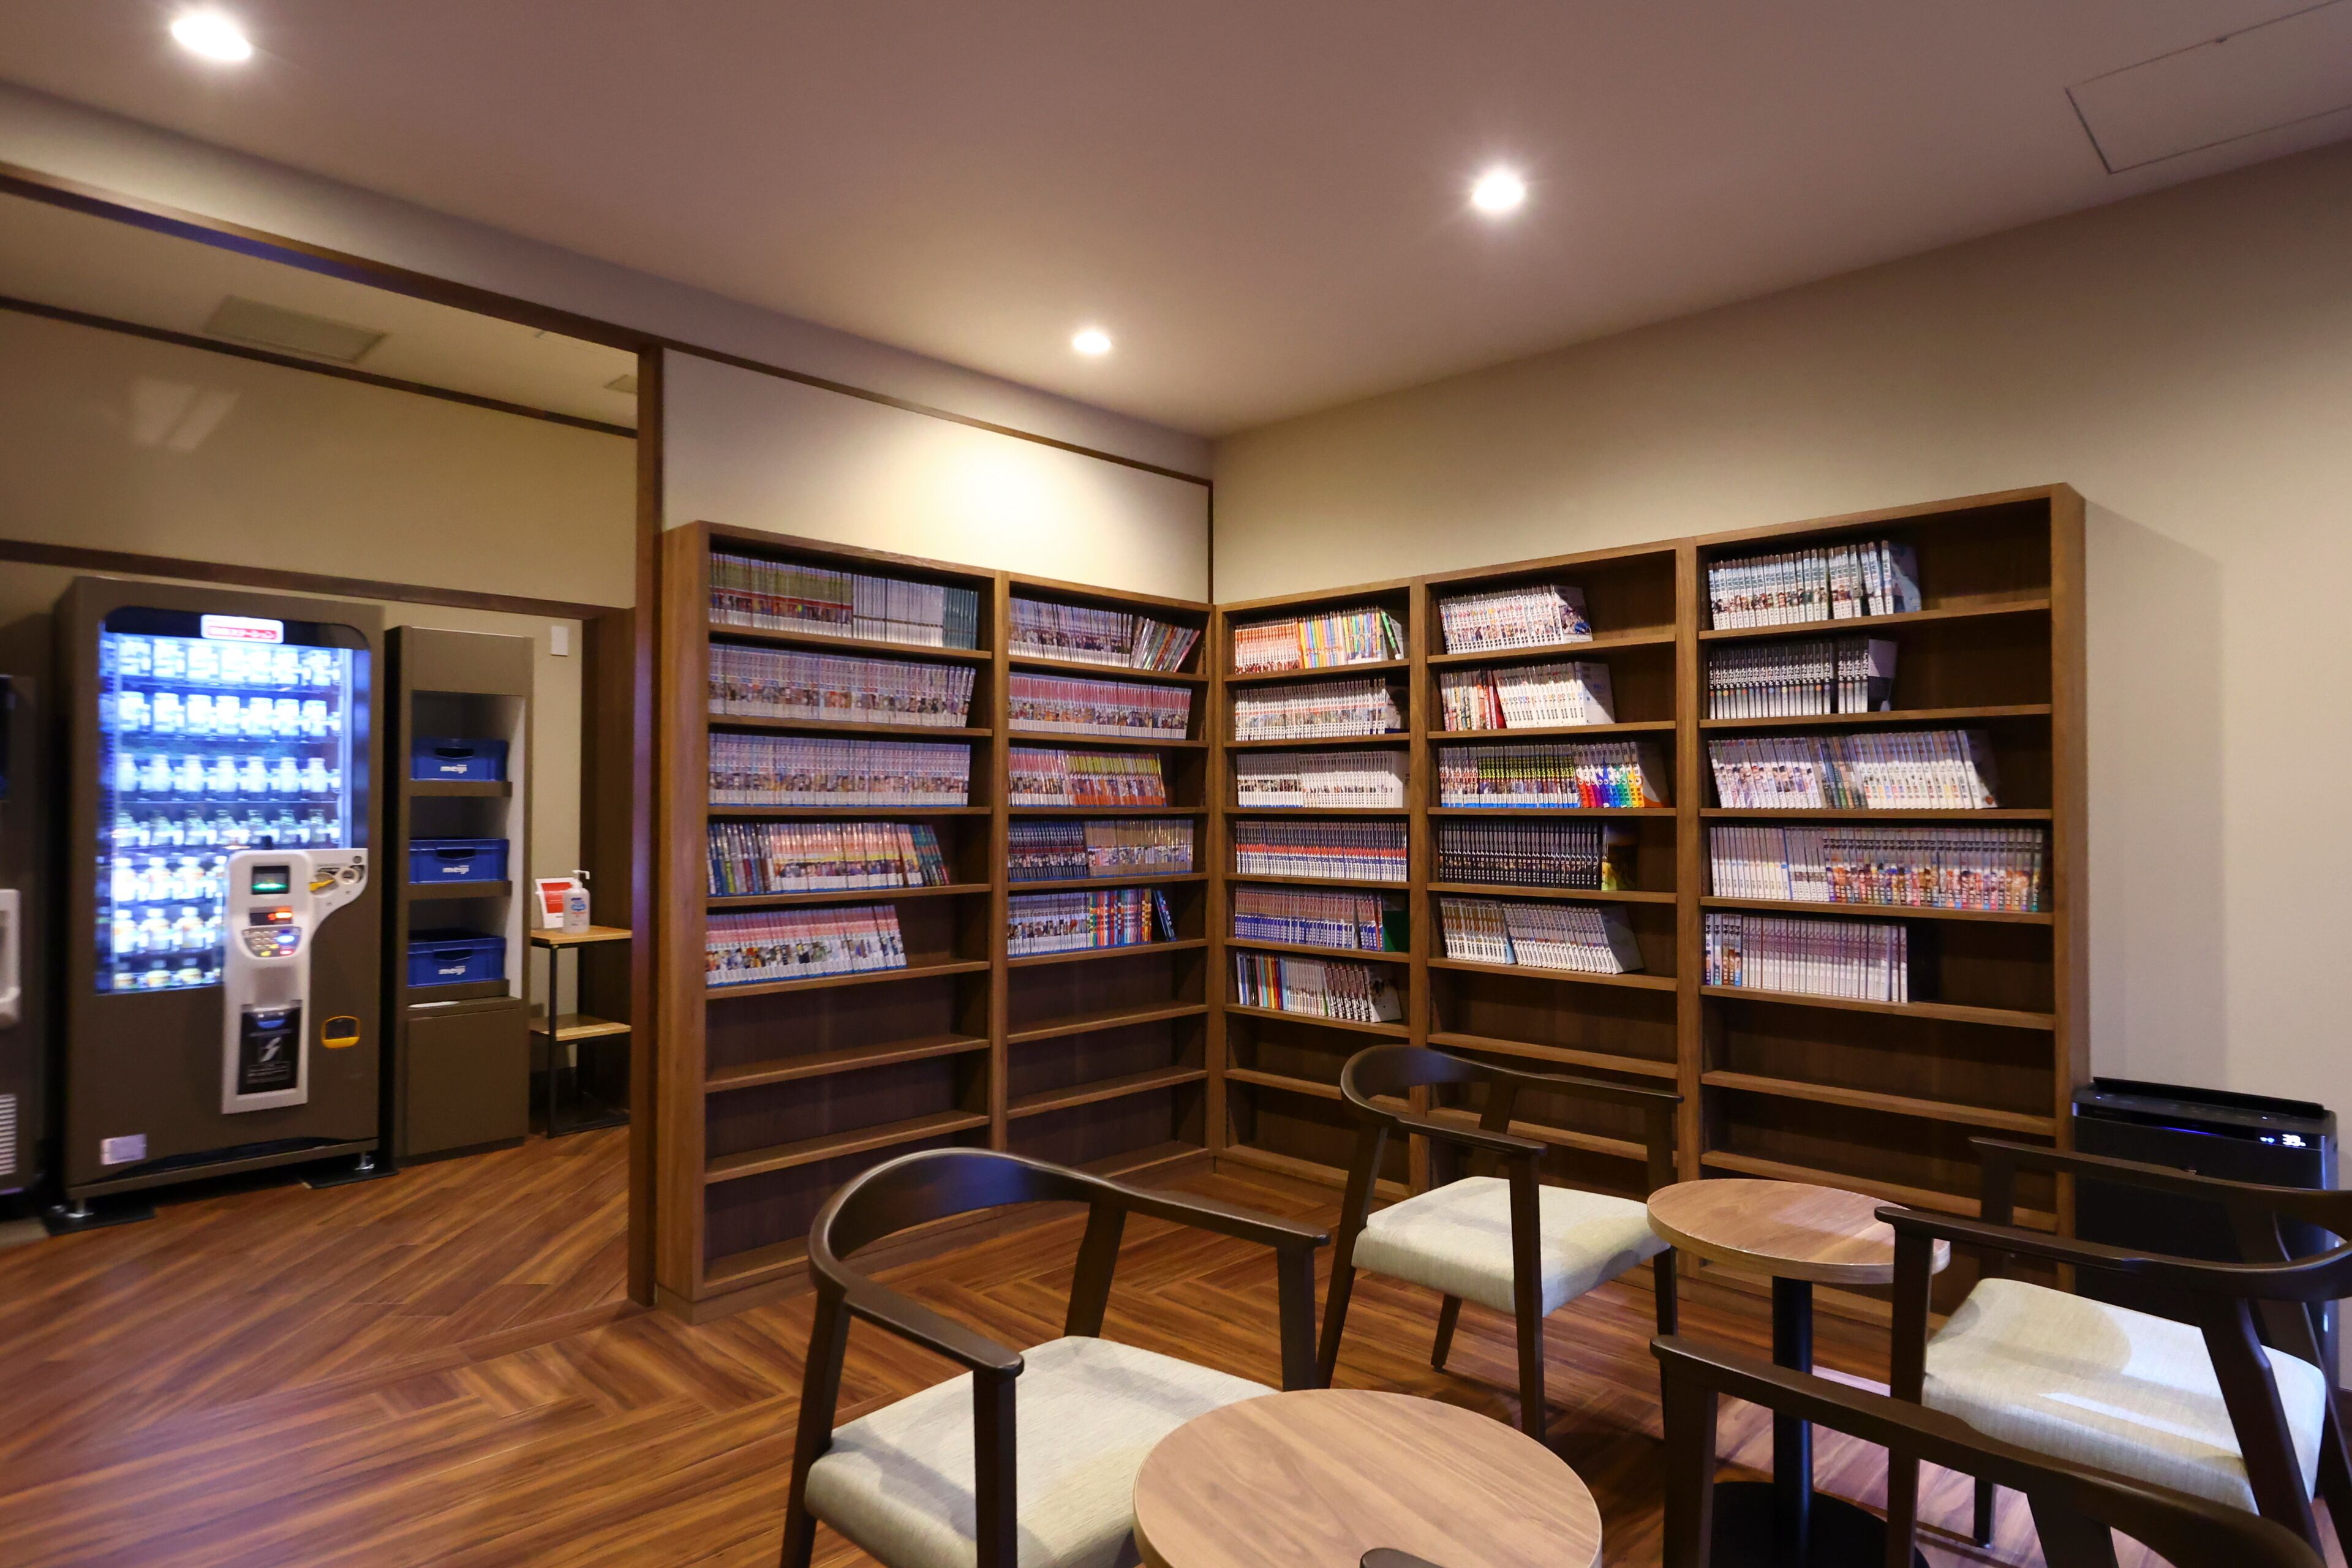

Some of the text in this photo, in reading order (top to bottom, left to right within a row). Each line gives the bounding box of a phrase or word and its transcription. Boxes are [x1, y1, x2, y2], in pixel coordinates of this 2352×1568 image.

[440, 764, 467, 774] meiji
[442, 865, 470, 875] meiji
[439, 965, 466, 975] meiji
